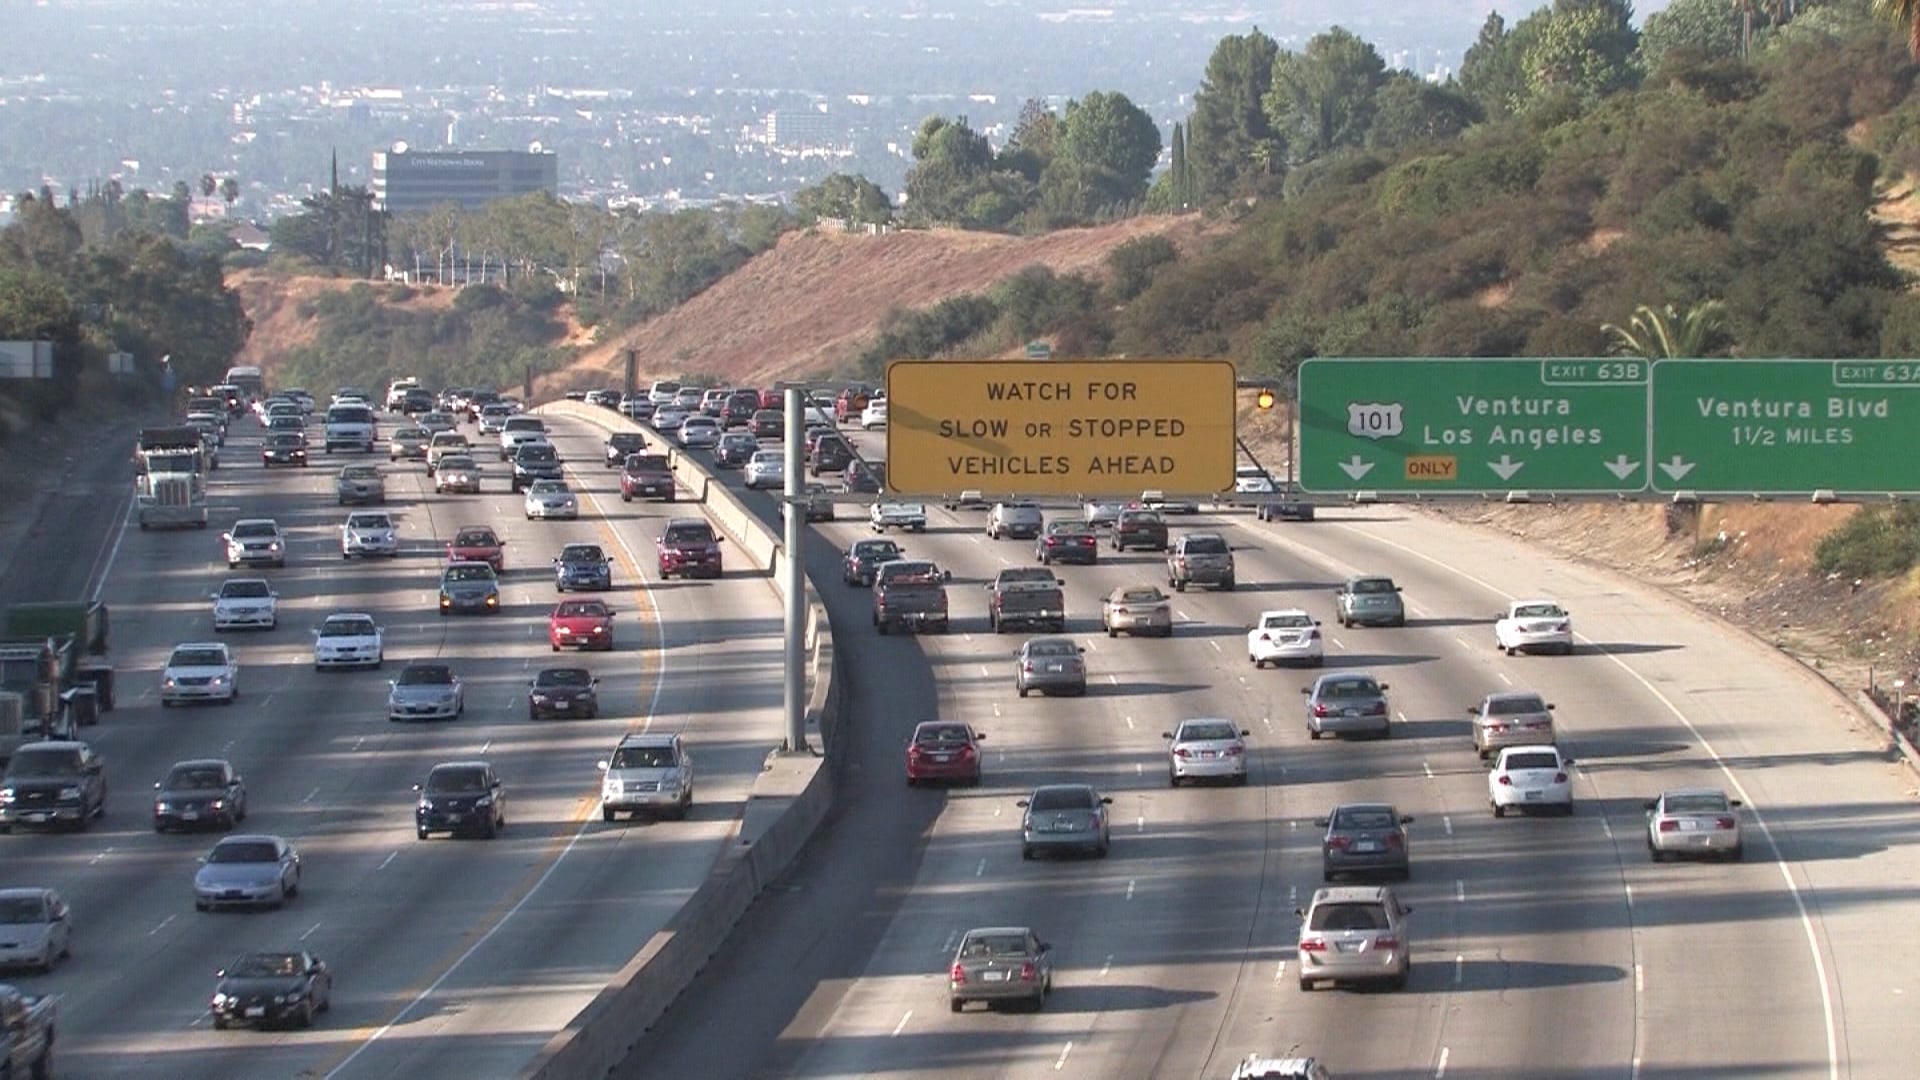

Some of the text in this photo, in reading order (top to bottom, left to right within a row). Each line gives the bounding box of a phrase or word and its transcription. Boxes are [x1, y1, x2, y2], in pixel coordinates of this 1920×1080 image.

[1551, 364, 1640, 379] EXIT 63B
[1841, 367, 1875, 378] EXIT
[987, 382, 1137, 400] WATCH FOR
[1456, 396, 1570, 415] Ventura
[1696, 397, 1889, 418] Ventura Blvd
[939, 419, 1185, 437] SLOW OR STOPPED
[1359, 412, 1393, 430] 101
[1423, 425, 1602, 449] Los Angeles
[1786, 427, 1853, 443] MILES
[948, 457, 1175, 474] VEHICLES AHEAD
[1408, 462, 1453, 475] ONLY
